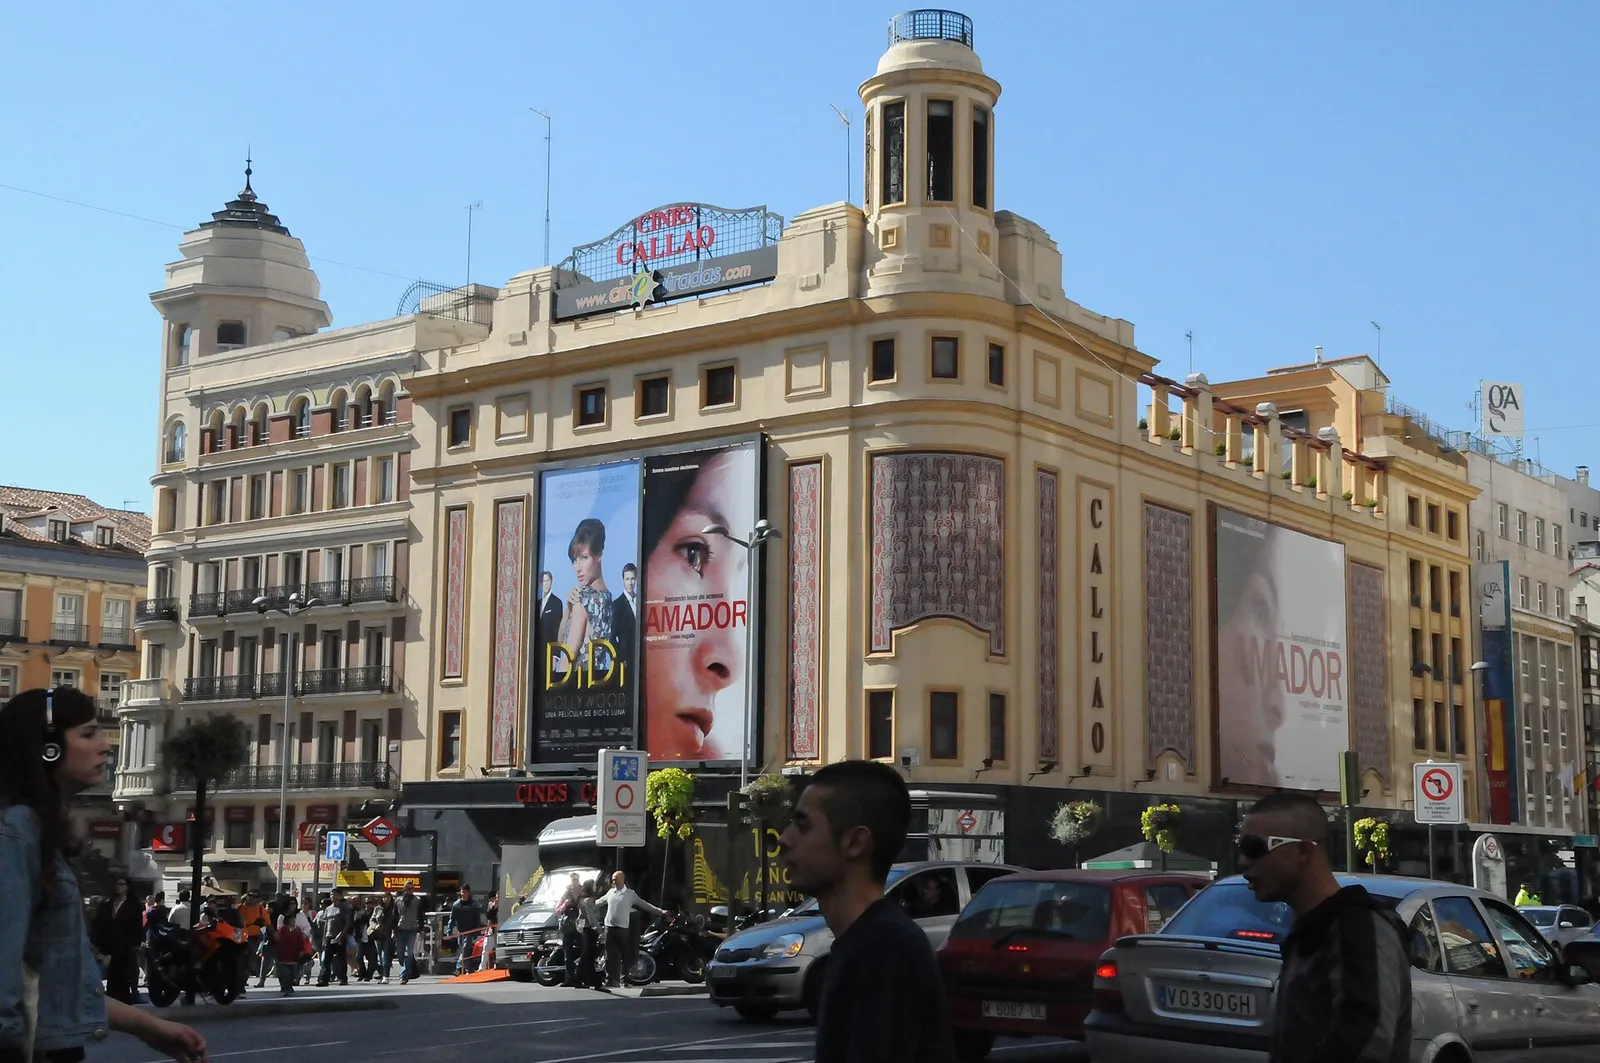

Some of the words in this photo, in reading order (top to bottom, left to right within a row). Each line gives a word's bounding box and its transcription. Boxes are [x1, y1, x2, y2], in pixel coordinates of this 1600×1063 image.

[637, 204, 694, 234] CINES
[616, 225, 715, 265] CALLAO
[645, 600, 746, 633] AMADOR
[1090, 498, 1105, 754] CALLAO
[1235, 632, 1343, 700] AMADOR
[545, 711, 557, 719] UNA
[584, 709, 592, 717] DE
[593, 709, 609, 717] BIGAS
[611, 708, 626, 716] LUNA
[516, 783, 569, 803] CINES
[329, 835, 341, 858] P
